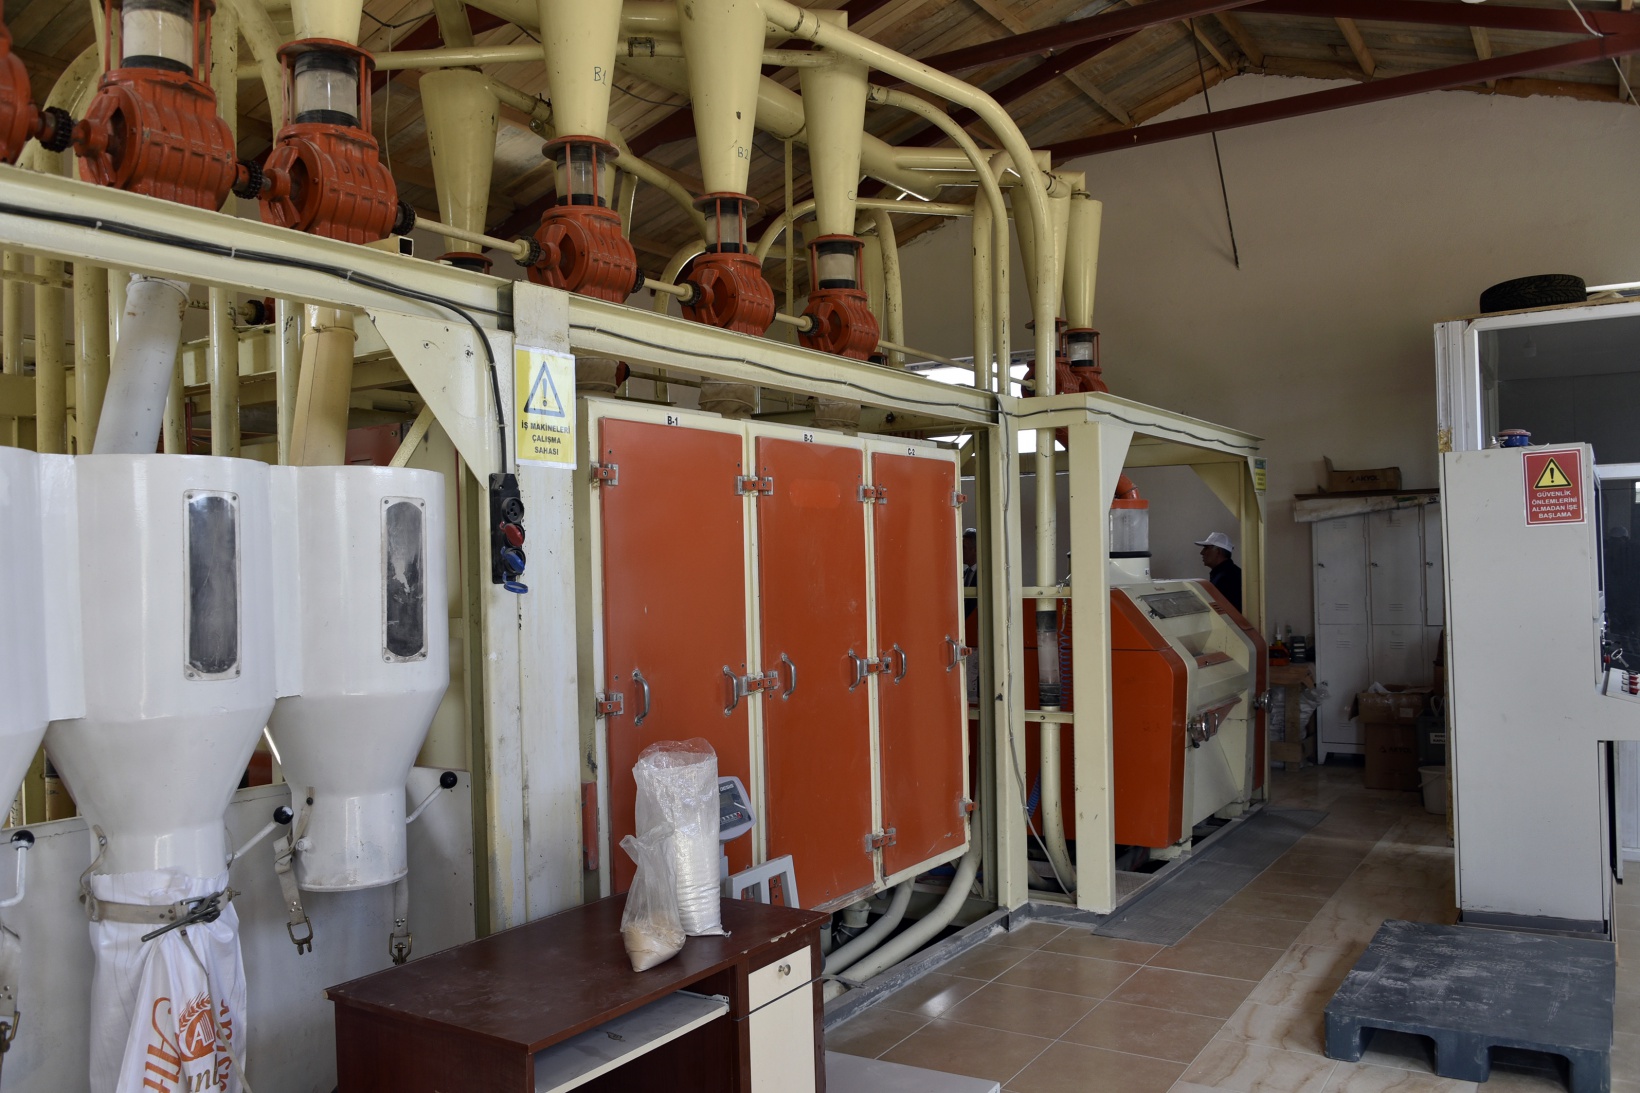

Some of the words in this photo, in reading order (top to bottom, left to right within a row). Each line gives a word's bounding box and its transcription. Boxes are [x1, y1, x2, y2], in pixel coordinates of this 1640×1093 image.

[594, 66, 607, 86] B1
[737, 146, 749, 160] B2
[667, 415, 679, 426] B-1
[521, 420, 529, 430] İŞ
[530, 422, 571, 434] MAKİNELERİ
[532, 434, 561, 444] ÇALIŞMA
[803, 433, 814, 443] B-2
[534, 446, 559, 455] SAHASI
[907, 448, 916, 456] C-2
[1536, 489, 1571, 498] GÜVENLİK
[1531, 496, 1578, 505] ÖNLEMLERİNİ
[1538, 511, 1572, 519] BAŞLAMA
